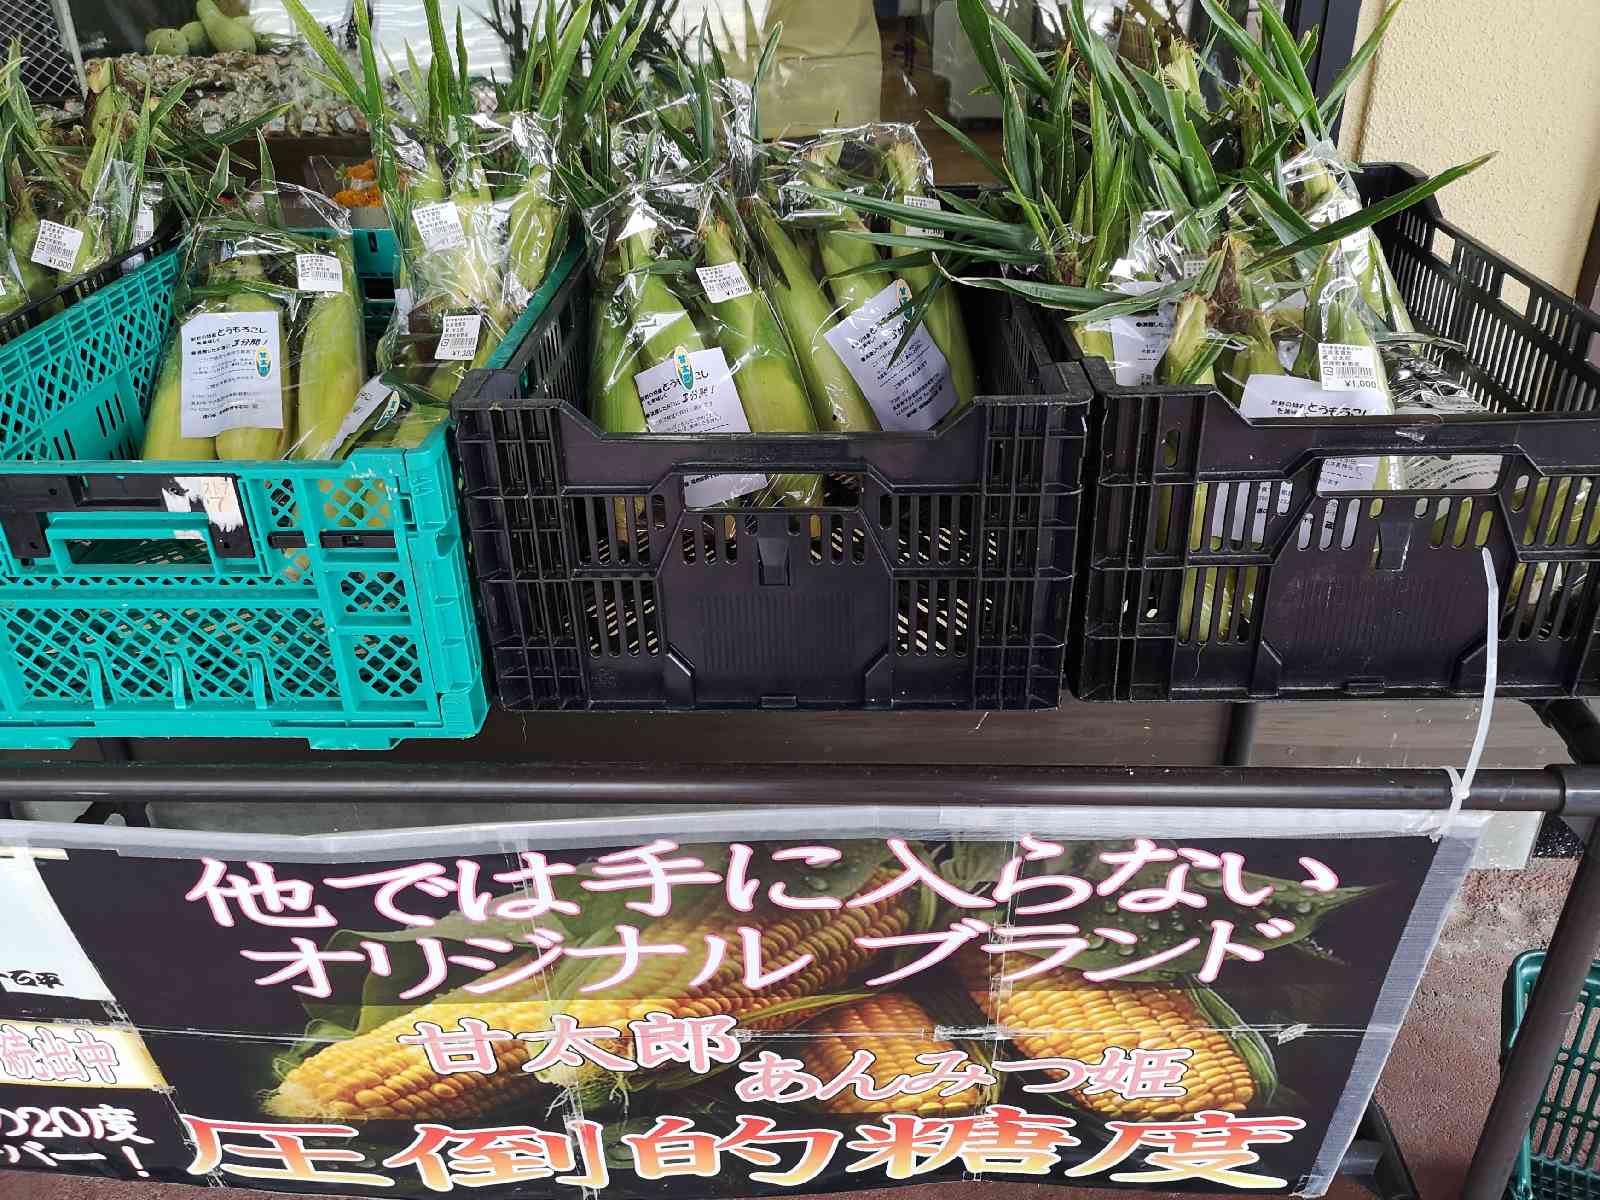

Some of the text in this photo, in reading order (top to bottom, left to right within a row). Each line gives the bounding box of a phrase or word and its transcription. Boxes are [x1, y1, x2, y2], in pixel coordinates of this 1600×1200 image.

[1344, 379, 1377, 389] ¥1,000
[185, 836, 1340, 928] 他では手に入らない
[239, 917, 1296, 1000] オリジナル ブランド
[398, 1011, 743, 1077] 甘太郎
[736, 1046, 1193, 1102] あんみつ姫
[180, 1104, 1305, 1194] 圧倒的糖度
